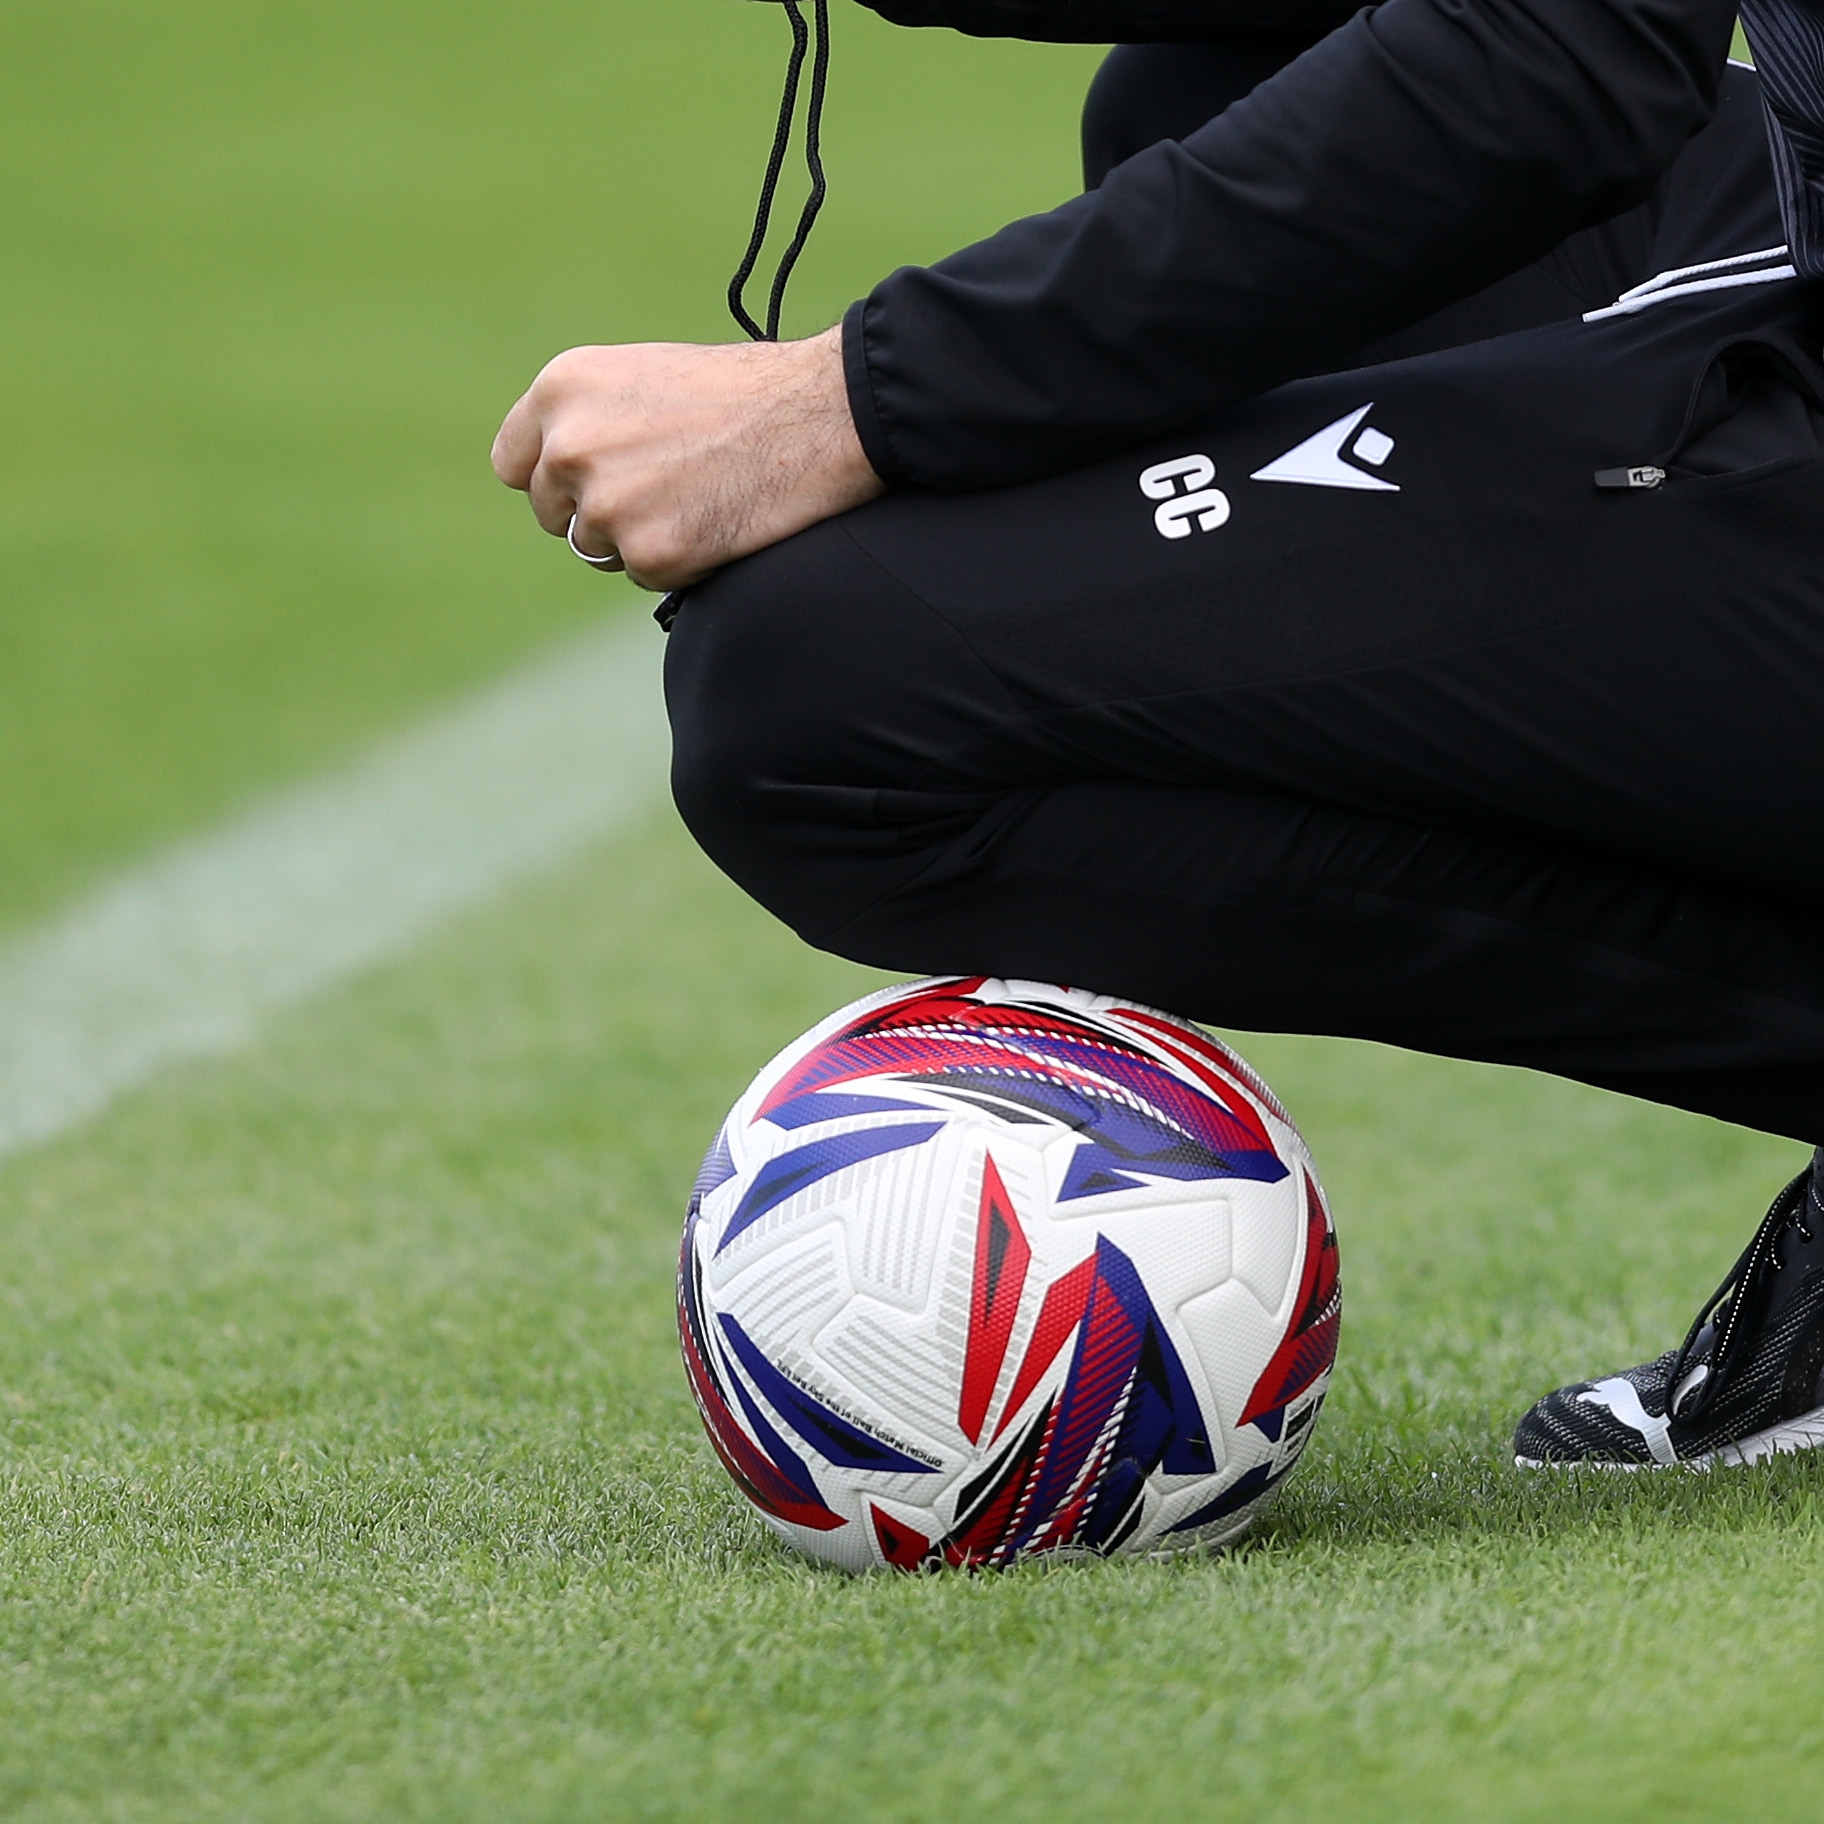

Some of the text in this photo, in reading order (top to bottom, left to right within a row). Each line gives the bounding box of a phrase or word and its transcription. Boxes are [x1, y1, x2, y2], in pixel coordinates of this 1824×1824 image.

[1139, 453, 1231, 540] CC
[807, 1386, 824, 1403] Sky
[826, 1397, 840, 1414] the
[841, 1407, 852, 1418] of
[853, 1417, 873, 1434] Ball
[874, 1428, 904, 1451] Match
[905, 1445, 944, 1468] Official
